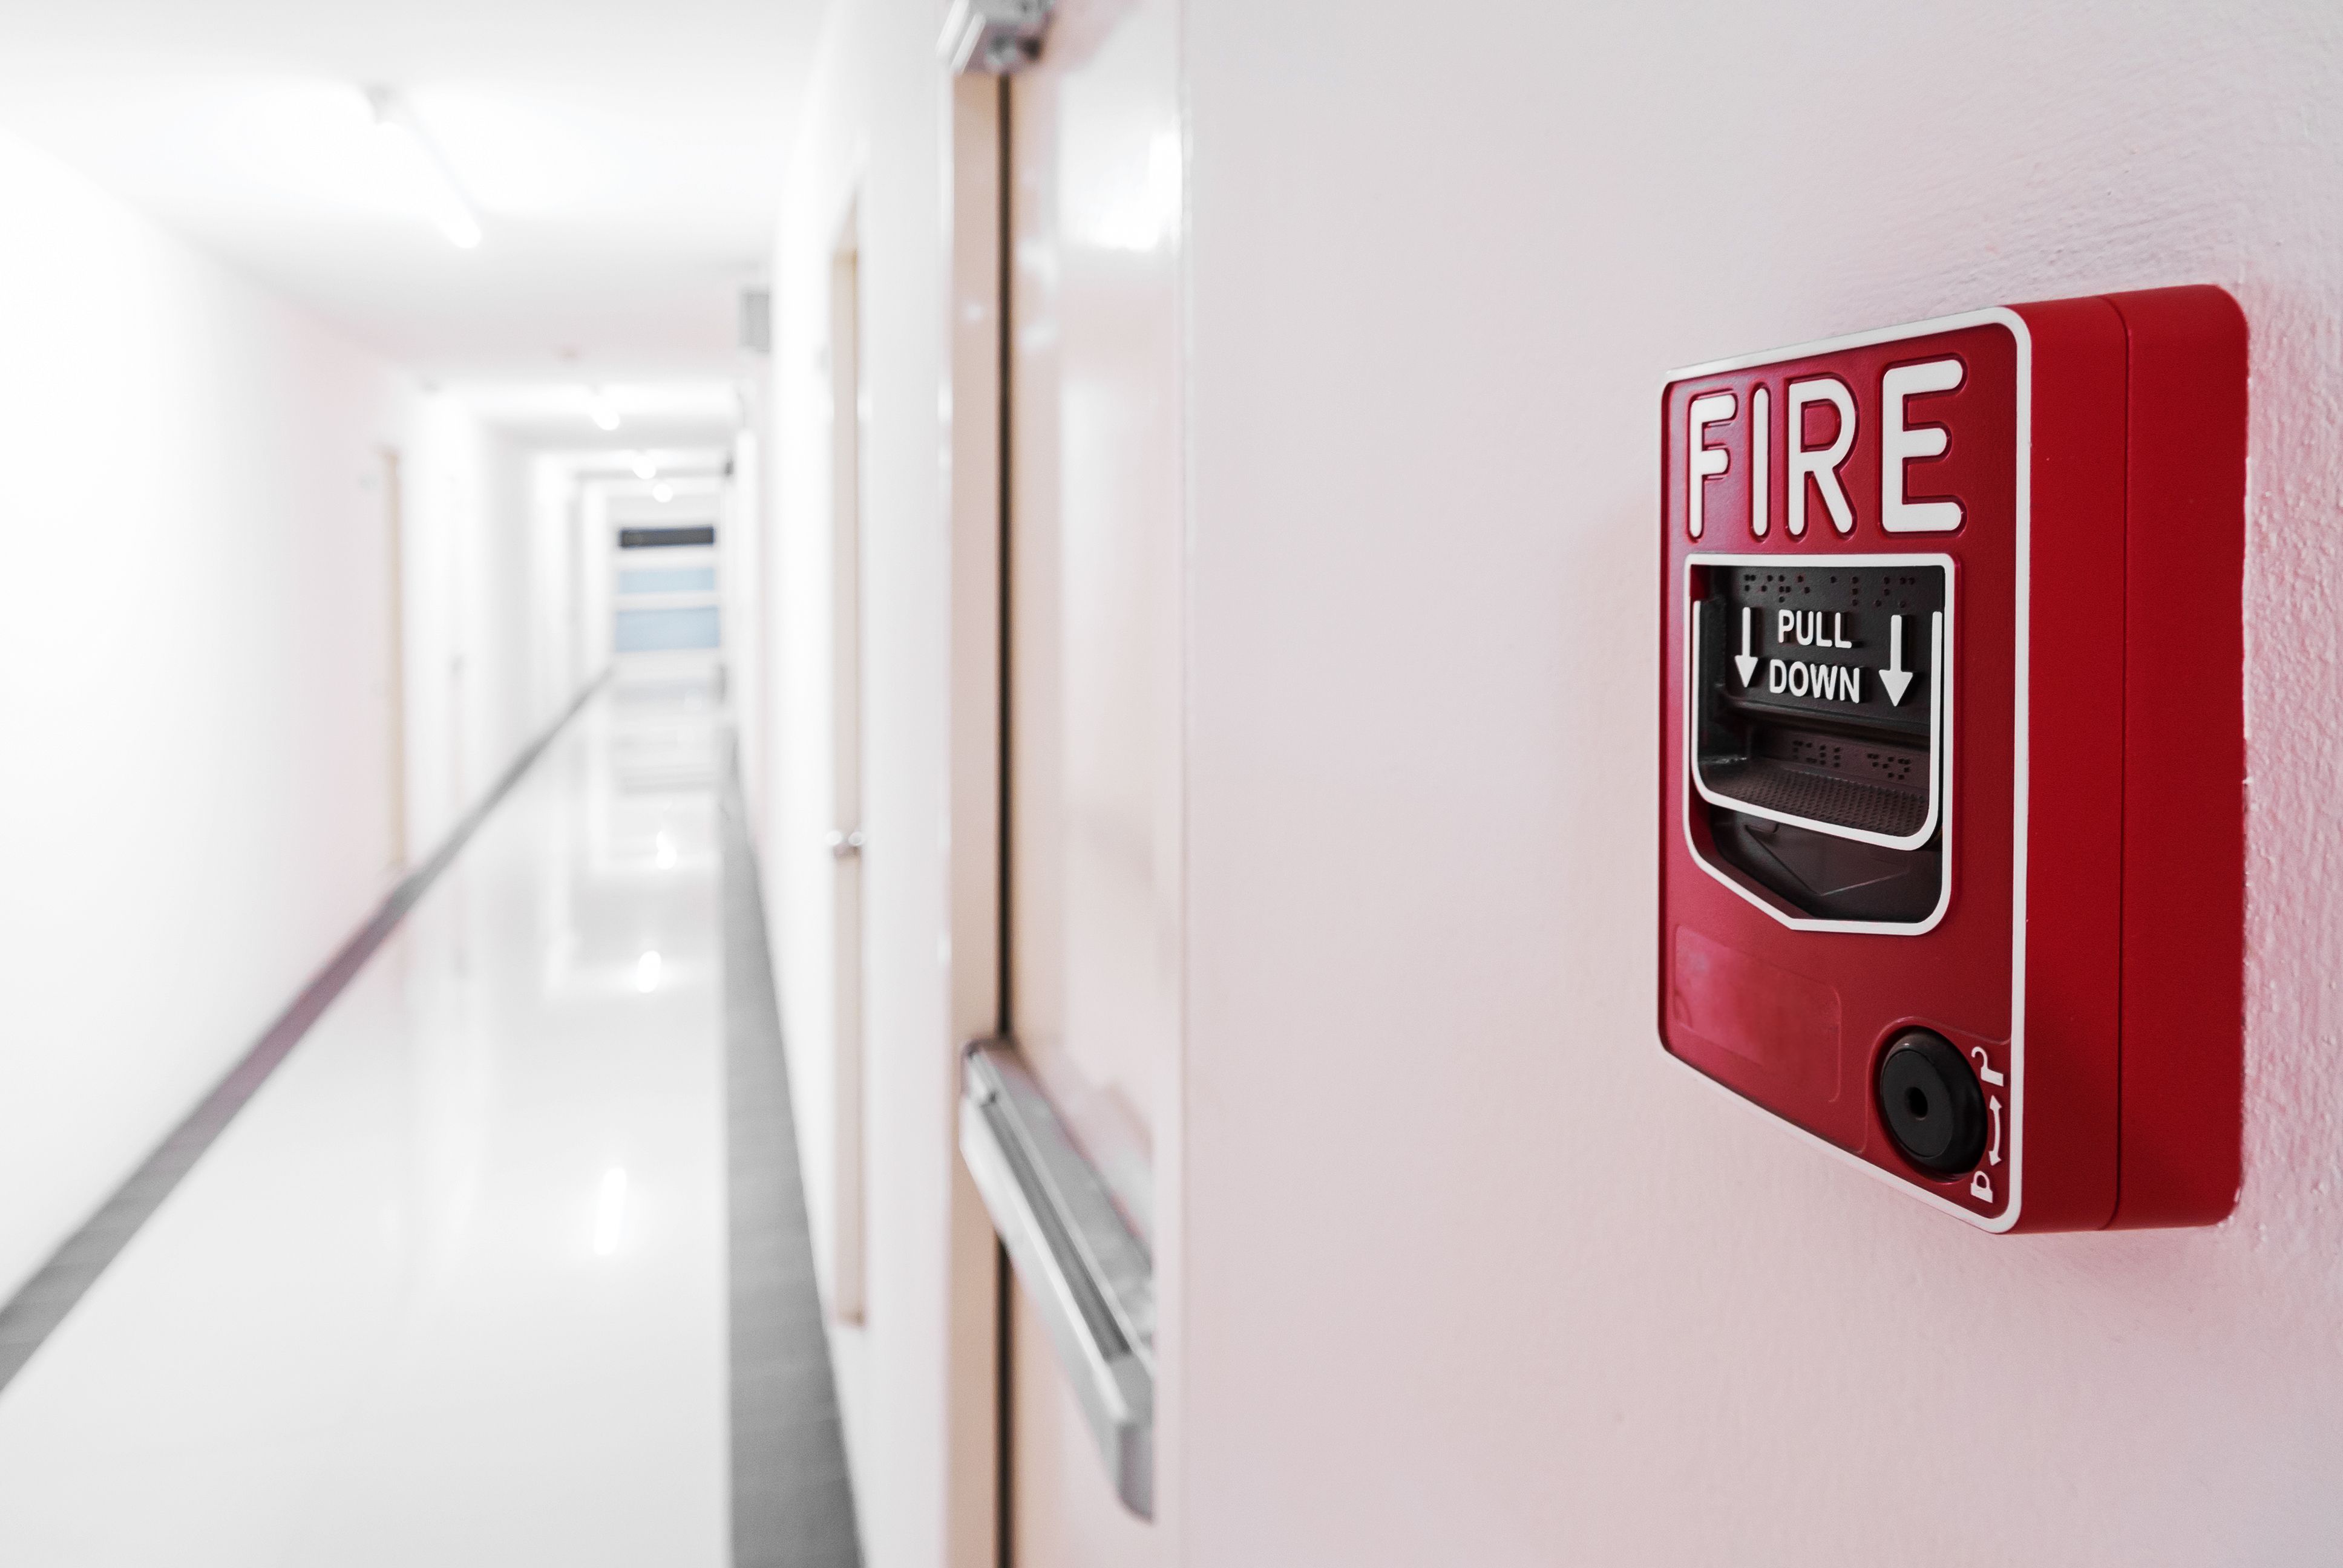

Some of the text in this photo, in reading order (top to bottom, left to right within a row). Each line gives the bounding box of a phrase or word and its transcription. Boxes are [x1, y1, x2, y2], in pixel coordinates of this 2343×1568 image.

[1689, 359, 1964, 537] FIRE
[1778, 609, 1852, 648] PULL
[1769, 659, 1860, 704] DOWN
